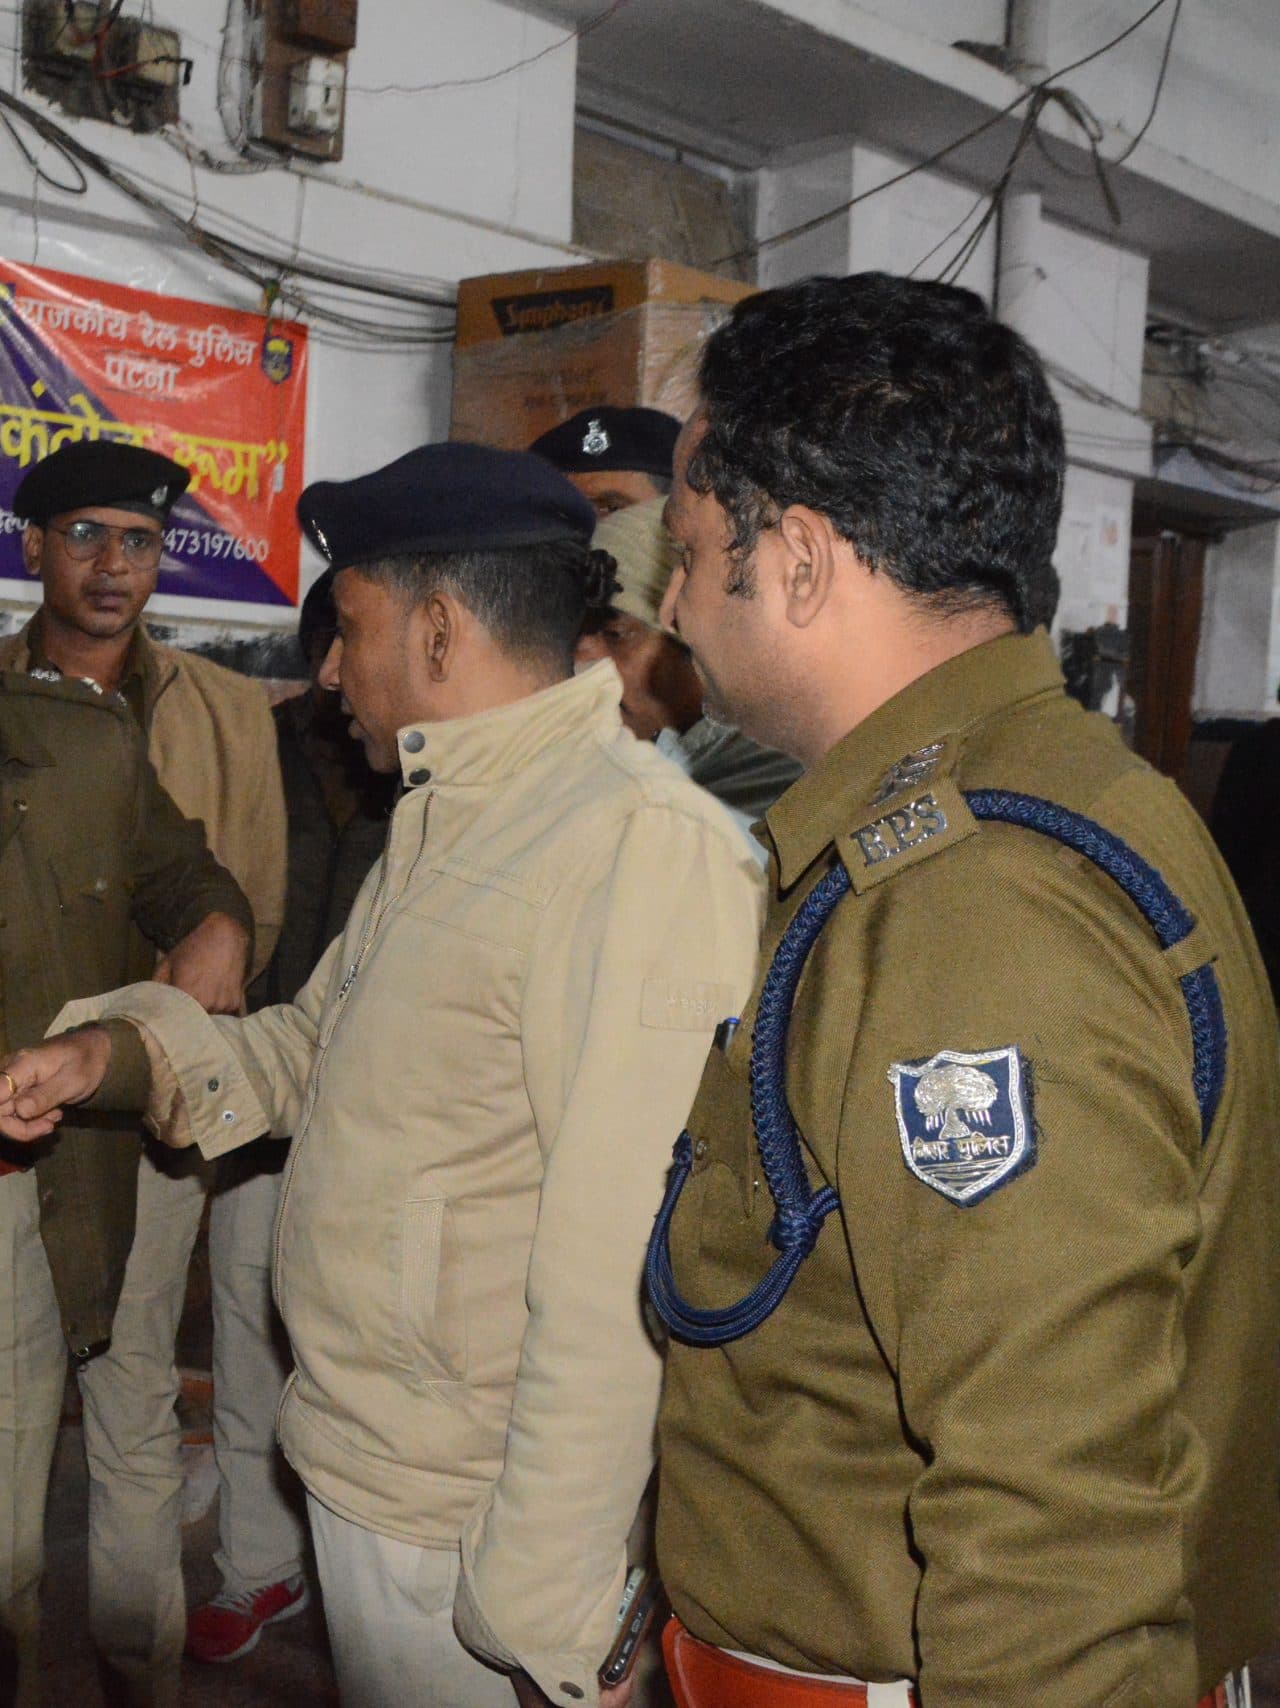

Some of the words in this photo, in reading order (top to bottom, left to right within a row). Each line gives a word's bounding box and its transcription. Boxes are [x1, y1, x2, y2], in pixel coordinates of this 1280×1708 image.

[187, 323, 259, 367] पुलिस
[104, 354, 181, 393] पटना
[160, 527, 269, 563] 473197600
[957, 1130, 1011, 1161] पुलिस
